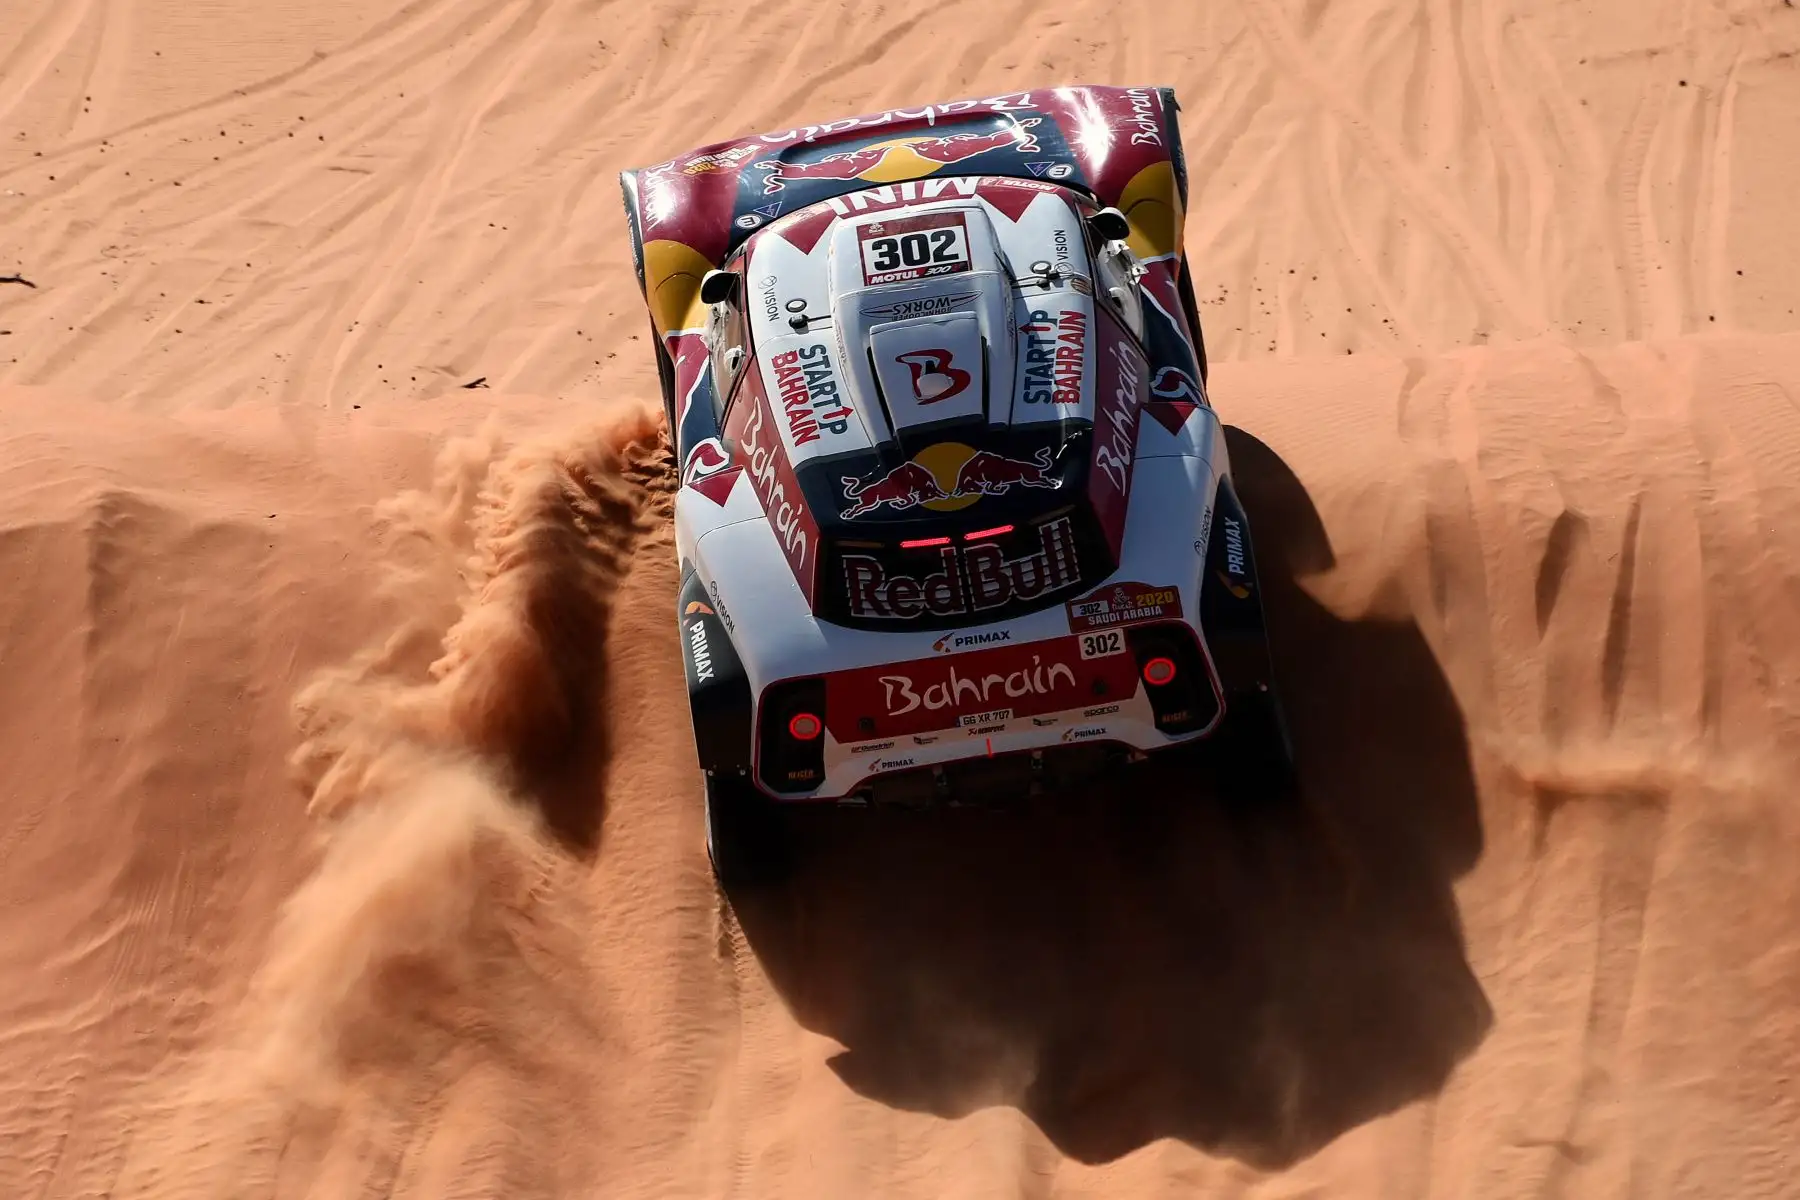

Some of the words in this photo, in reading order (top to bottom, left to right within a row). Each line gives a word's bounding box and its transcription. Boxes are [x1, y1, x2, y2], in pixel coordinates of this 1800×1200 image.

[760, 93, 1039, 143] Bahrain
[1120, 88, 1161, 146] Bahrain
[828, 176, 983, 216] MINI
[871, 229, 960, 271] 302
[1056, 229, 1066, 261] VISION
[870, 270, 919, 286] MOTUL
[763, 288, 780, 322] VISION
[893, 297, 950, 315] WORKS
[1052, 310, 1087, 405] BAHRAIN
[771, 350, 821, 447] BAHRAIN
[1096, 341, 1138, 497] Bahrain
[741, 396, 806, 570] Bahrain
[1224, 517, 1245, 575] PRIMAX
[842, 546, 966, 620] Red
[963, 517, 1081, 612] Bull
[716, 595, 735, 635] VISION
[1080, 602, 1102, 616] 302
[1135, 591, 1174, 608] 2020
[1088, 612, 1120, 626] SAUDI
[1123, 606, 1163, 622] ARABIA
[690, 620, 715, 684] PRIMAX
[955, 630, 1011, 648] PRIMAX
[1083, 632, 1121, 657] 302
[879, 655, 1076, 717] Bahrain
[963, 716, 976, 726] GG
[978, 713, 991, 724] XR
[992, 710, 1010, 721] 707
[1074, 727, 1107, 739] PRIMAX
[881, 757, 914, 769] PRIMAX
